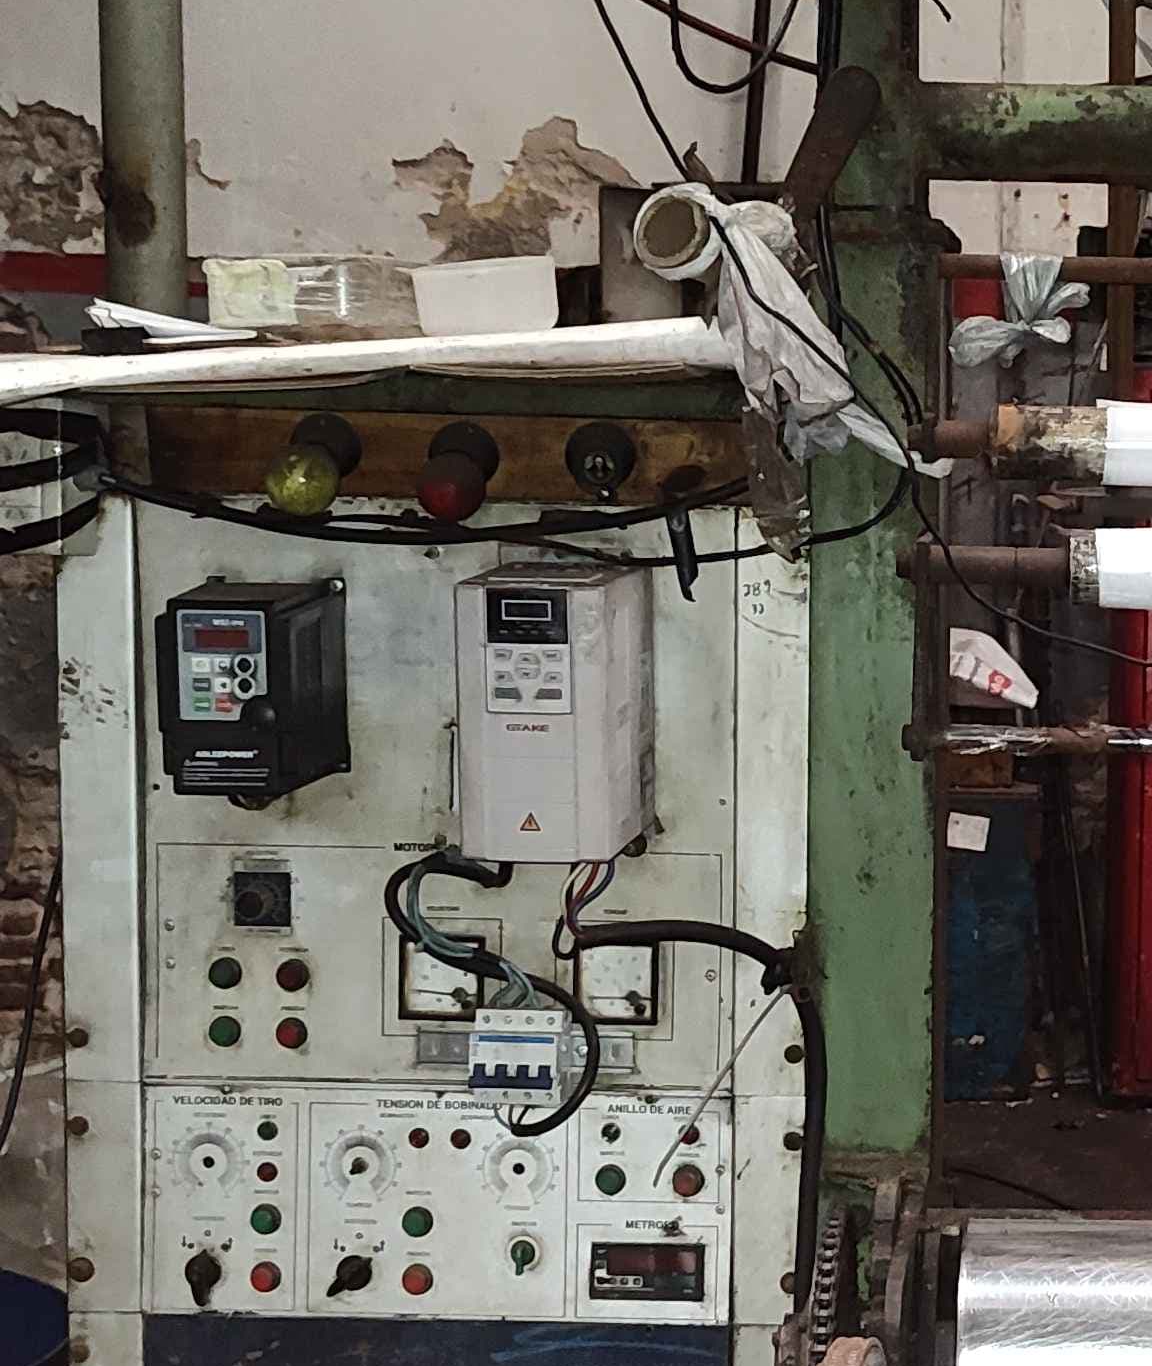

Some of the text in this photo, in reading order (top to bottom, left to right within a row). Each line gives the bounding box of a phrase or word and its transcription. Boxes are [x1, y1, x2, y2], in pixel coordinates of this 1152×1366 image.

[172, 1095, 283, 1107] VELOCIDAD DE TIRO
[376, 1098, 424, 1109] TENSION
[427, 1099, 441, 1109] DE
[607, 1104, 647, 1114] ANILLO
[649, 1104, 665, 1115] DE
